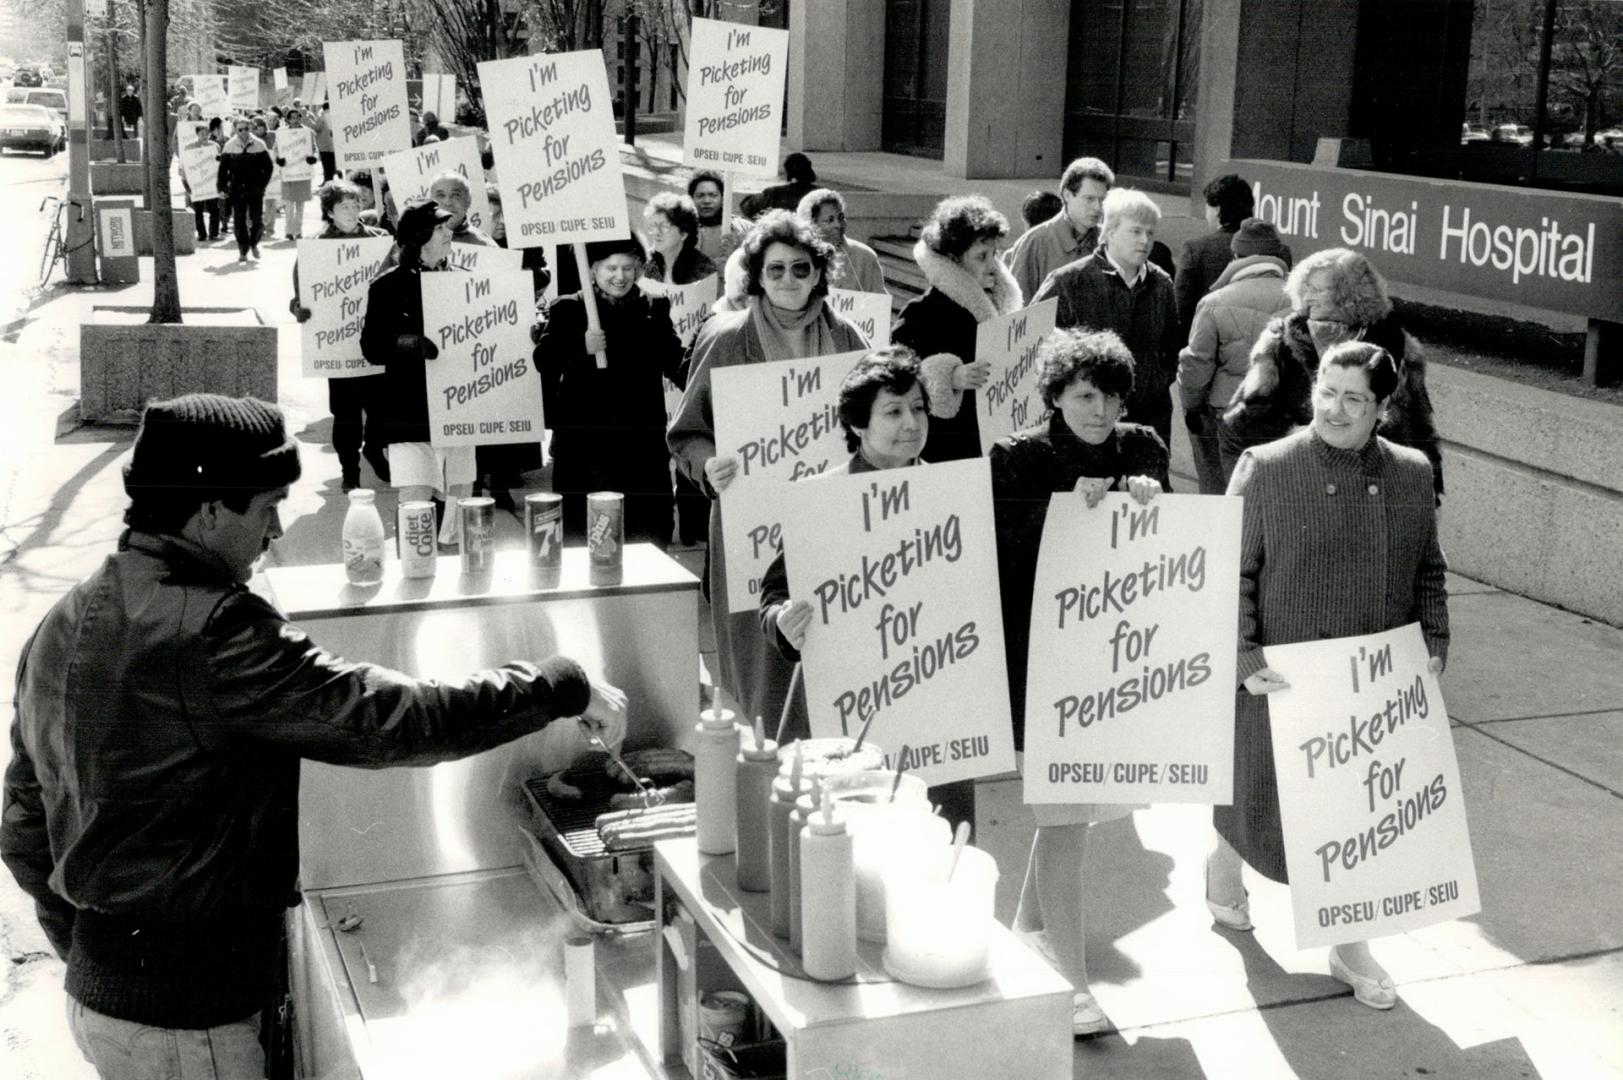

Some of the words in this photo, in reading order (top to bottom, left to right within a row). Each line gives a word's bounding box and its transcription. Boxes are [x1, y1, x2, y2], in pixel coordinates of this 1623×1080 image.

[354, 46, 373, 65] I'm
[727, 29, 751, 51] I'm
[337, 61, 393, 100] Picketing
[528, 62, 558, 92] I'm
[700, 53, 771, 86] Picketing
[360, 93, 379, 116] for
[504, 83, 592, 145] Picketing
[724, 85, 747, 110] for
[342, 105, 401, 143] Pensions
[698, 104, 771, 137] Pensions
[417, 149, 440, 175] I'm
[542, 134, 570, 167] for
[517, 149, 606, 208] Pensions
[337, 244, 360, 264] I'm
[1340, 192, 1418, 255] Sinai
[1440, 205, 1596, 284] Hospital
[340, 296, 363, 320] for
[464, 277, 490, 303] I'm
[315, 317, 365, 349] Pensi
[438, 299, 518, 350] Picketing
[1008, 315, 1027, 352] I'm
[471, 342, 497, 372] for
[442, 358, 528, 410] Pensions
[781, 366, 821, 407] I'm
[1011, 395, 1029, 432] for
[737, 402, 841, 476] Picketin
[862, 480, 910, 532] I'm
[1111, 503, 1160, 549] I'm
[405, 514, 420, 546] diet
[416, 512, 434, 557] Coke
[813, 513, 962, 625] Picketing
[1054, 545, 1206, 629] Picketing
[875, 601, 923, 660] for
[1108, 619, 1159, 674] for
[833, 621, 980, 736] Pensions
[1350, 643, 1393, 693] I'm
[1053, 652, 1212, 737] Pensions
[1299, 674, 1429, 778] Picketing
[1363, 757, 1406, 813] for
[1314, 773, 1447, 883] Pensions
